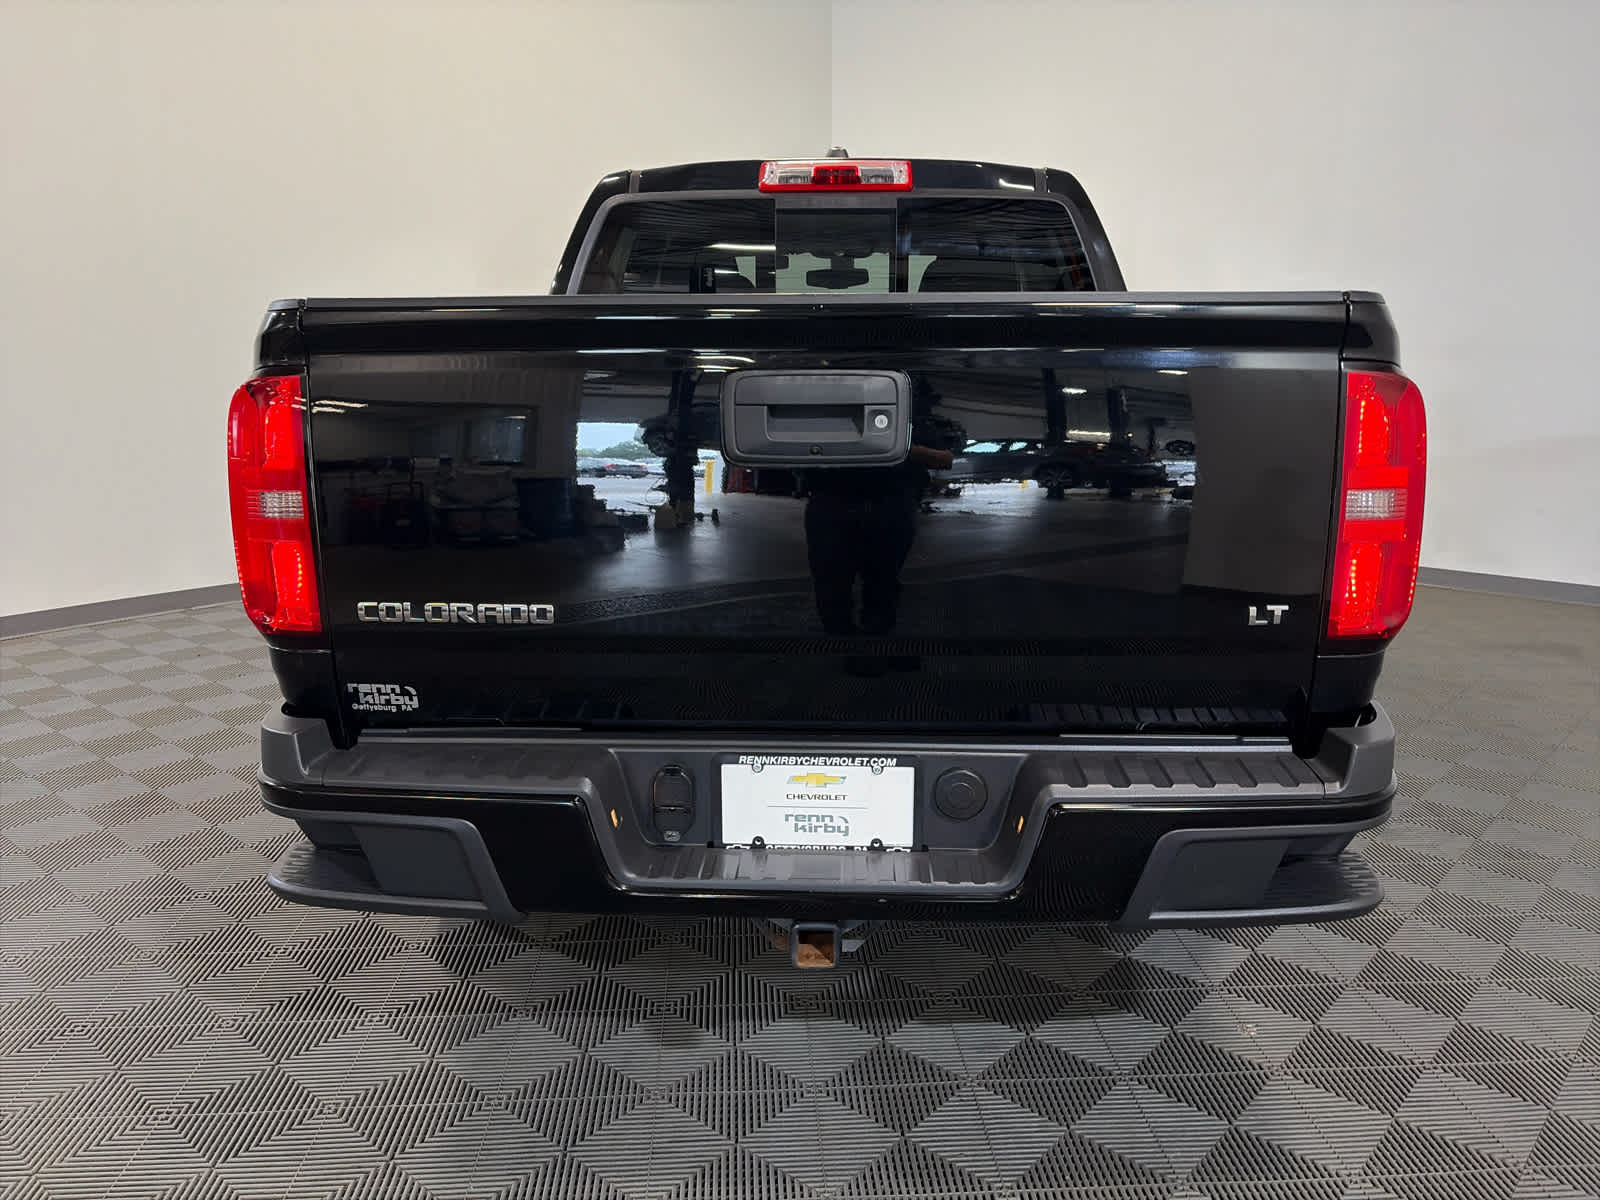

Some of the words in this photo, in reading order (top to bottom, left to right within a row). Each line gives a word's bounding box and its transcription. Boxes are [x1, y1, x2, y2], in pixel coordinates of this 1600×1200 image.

[357, 602, 554, 624] COLORADO
[1248, 605, 1289, 625] LT
[347, 683, 401, 694] renn
[358, 692, 419, 708] kirby
[351, 703, 397, 712] Gettysburg
[738, 755, 897, 767] RENNKIRBYCHEVROLET.COM
[786, 793, 848, 801] CHEVROLET
[784, 813, 834, 823] renn
[794, 823, 849, 836] kirby
